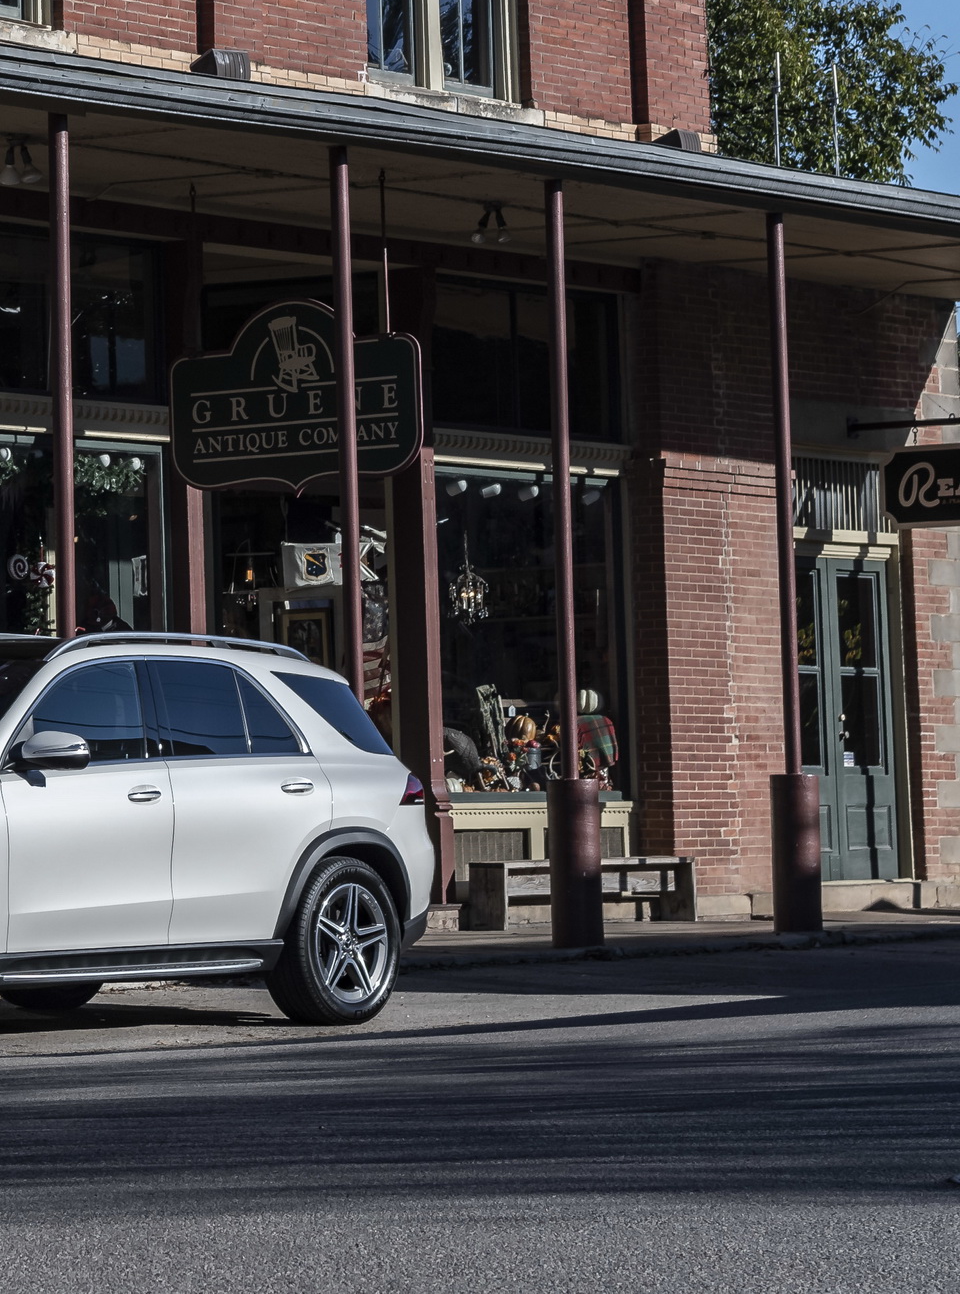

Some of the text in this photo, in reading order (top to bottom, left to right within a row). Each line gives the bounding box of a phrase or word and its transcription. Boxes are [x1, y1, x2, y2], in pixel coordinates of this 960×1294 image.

[193, 421, 399, 454] ANTIQUE COMANY
[898, 461, 960, 508] RE
